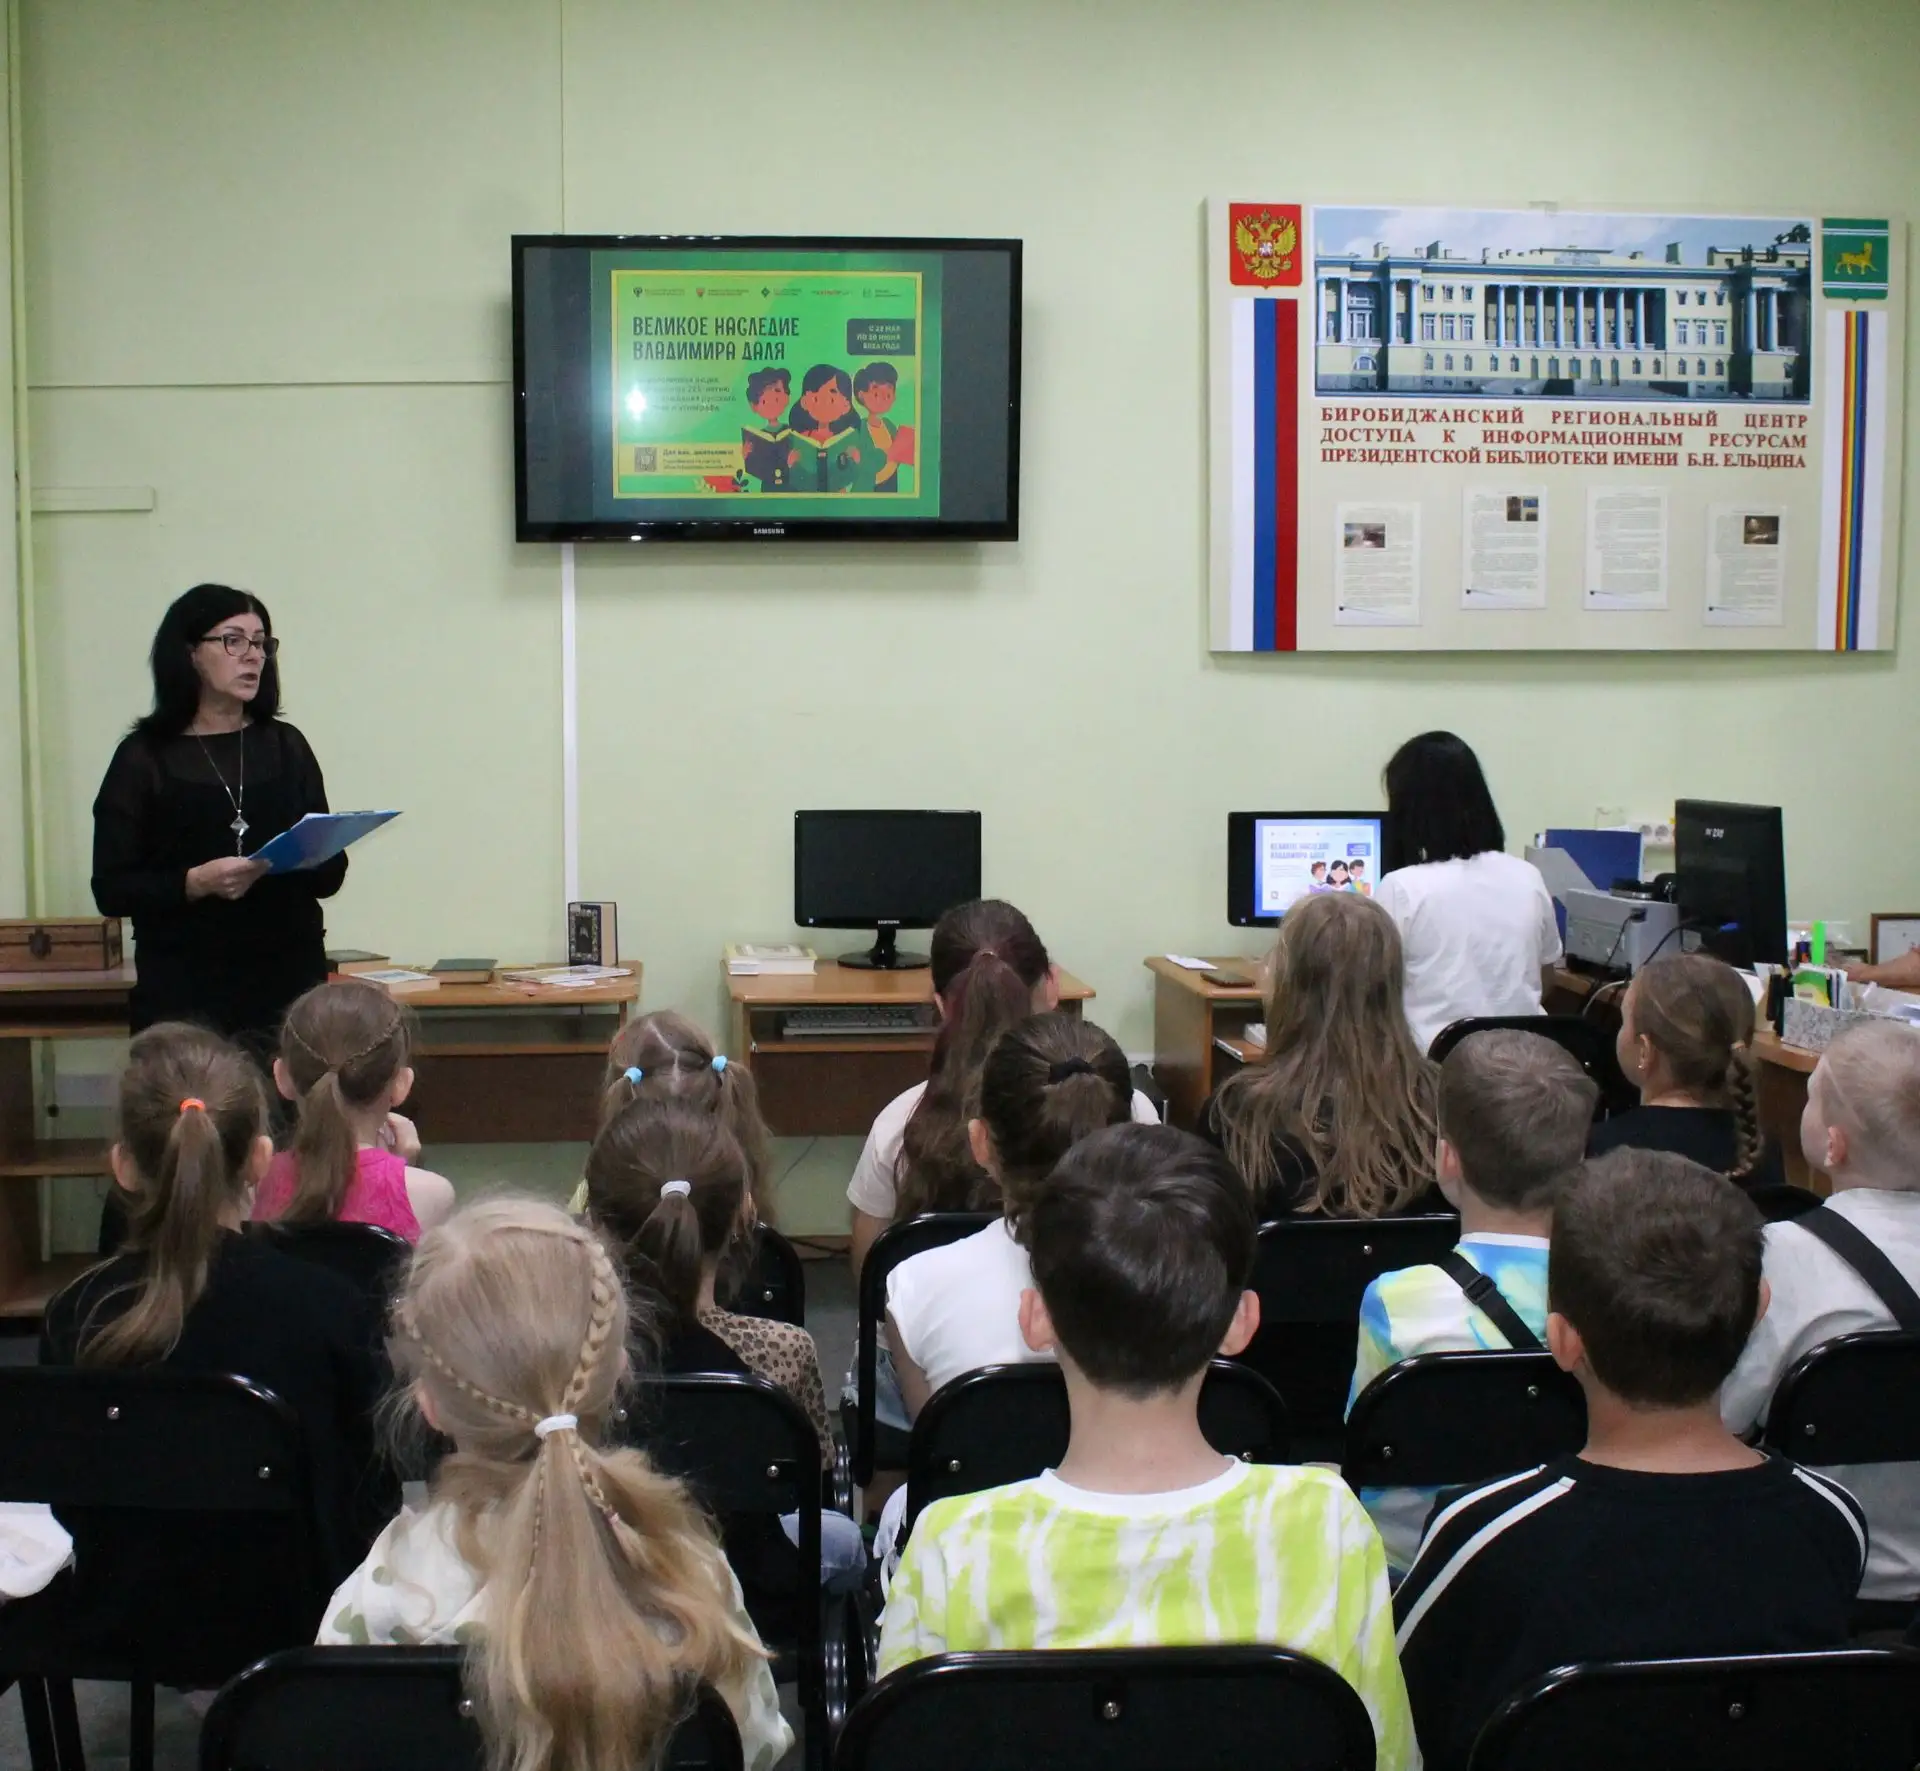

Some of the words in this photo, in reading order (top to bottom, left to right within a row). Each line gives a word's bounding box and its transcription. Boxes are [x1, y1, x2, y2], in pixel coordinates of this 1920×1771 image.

[632, 316, 708, 337] ВЕЛИКОЕ
[715, 316, 799, 337] НАСЛЕДИЕ
[633, 340, 736, 361] ВЛАДИМИРА
[741, 340, 785, 361] ДАЛЯ
[1320, 406, 1525, 424] БИРОБИДЖАНСКИЙ
[1551, 409, 1718, 427] РЕГИОНАЛЬНЫЙ
[1744, 412, 1808, 429] ЦЕНТР
[1320, 427, 1416, 445] ДОСТУПА
[1442, 428, 1456, 444] К
[1482, 430, 1683, 448] ИНФОРМАЦИОННЫМ
[1709, 432, 1808, 449] РЕСУРСАМ
[1320, 446, 1481, 465] ПРЕЗИДЕНТСКОЙ
[1485, 450, 1609, 466] БИБЛИОТЕКИ
[1613, 451, 1679, 467] ИМЕНИ
[1687, 452, 1719, 468] Б.Н.
[1723, 452, 1807, 470] ЕЛЬЦИНА
[753, 527, 785, 535] SAMSUNG
